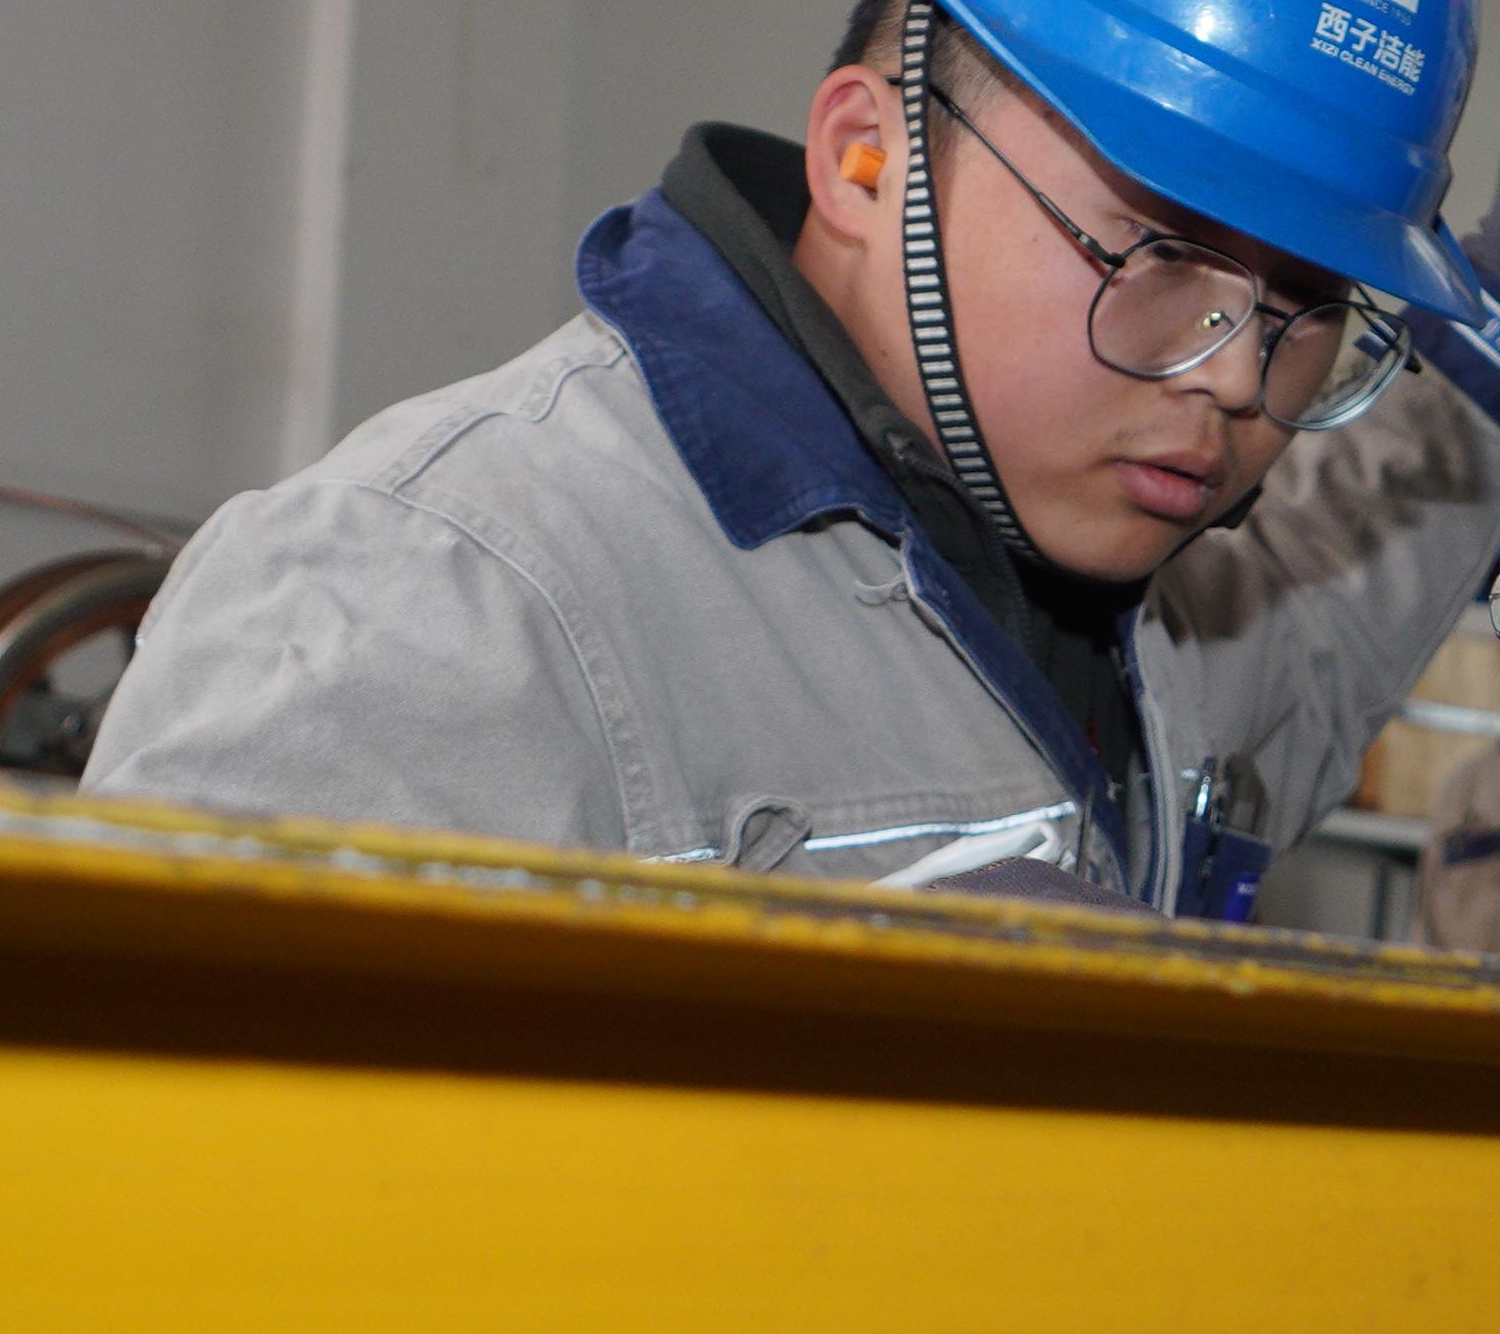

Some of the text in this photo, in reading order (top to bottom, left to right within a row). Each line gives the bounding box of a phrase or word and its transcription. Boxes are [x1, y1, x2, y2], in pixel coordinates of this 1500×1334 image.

[1311, 37, 1416, 96] XIZI CLEAN ENERGY
[1316, 3, 1425, 82] 西子洁能
